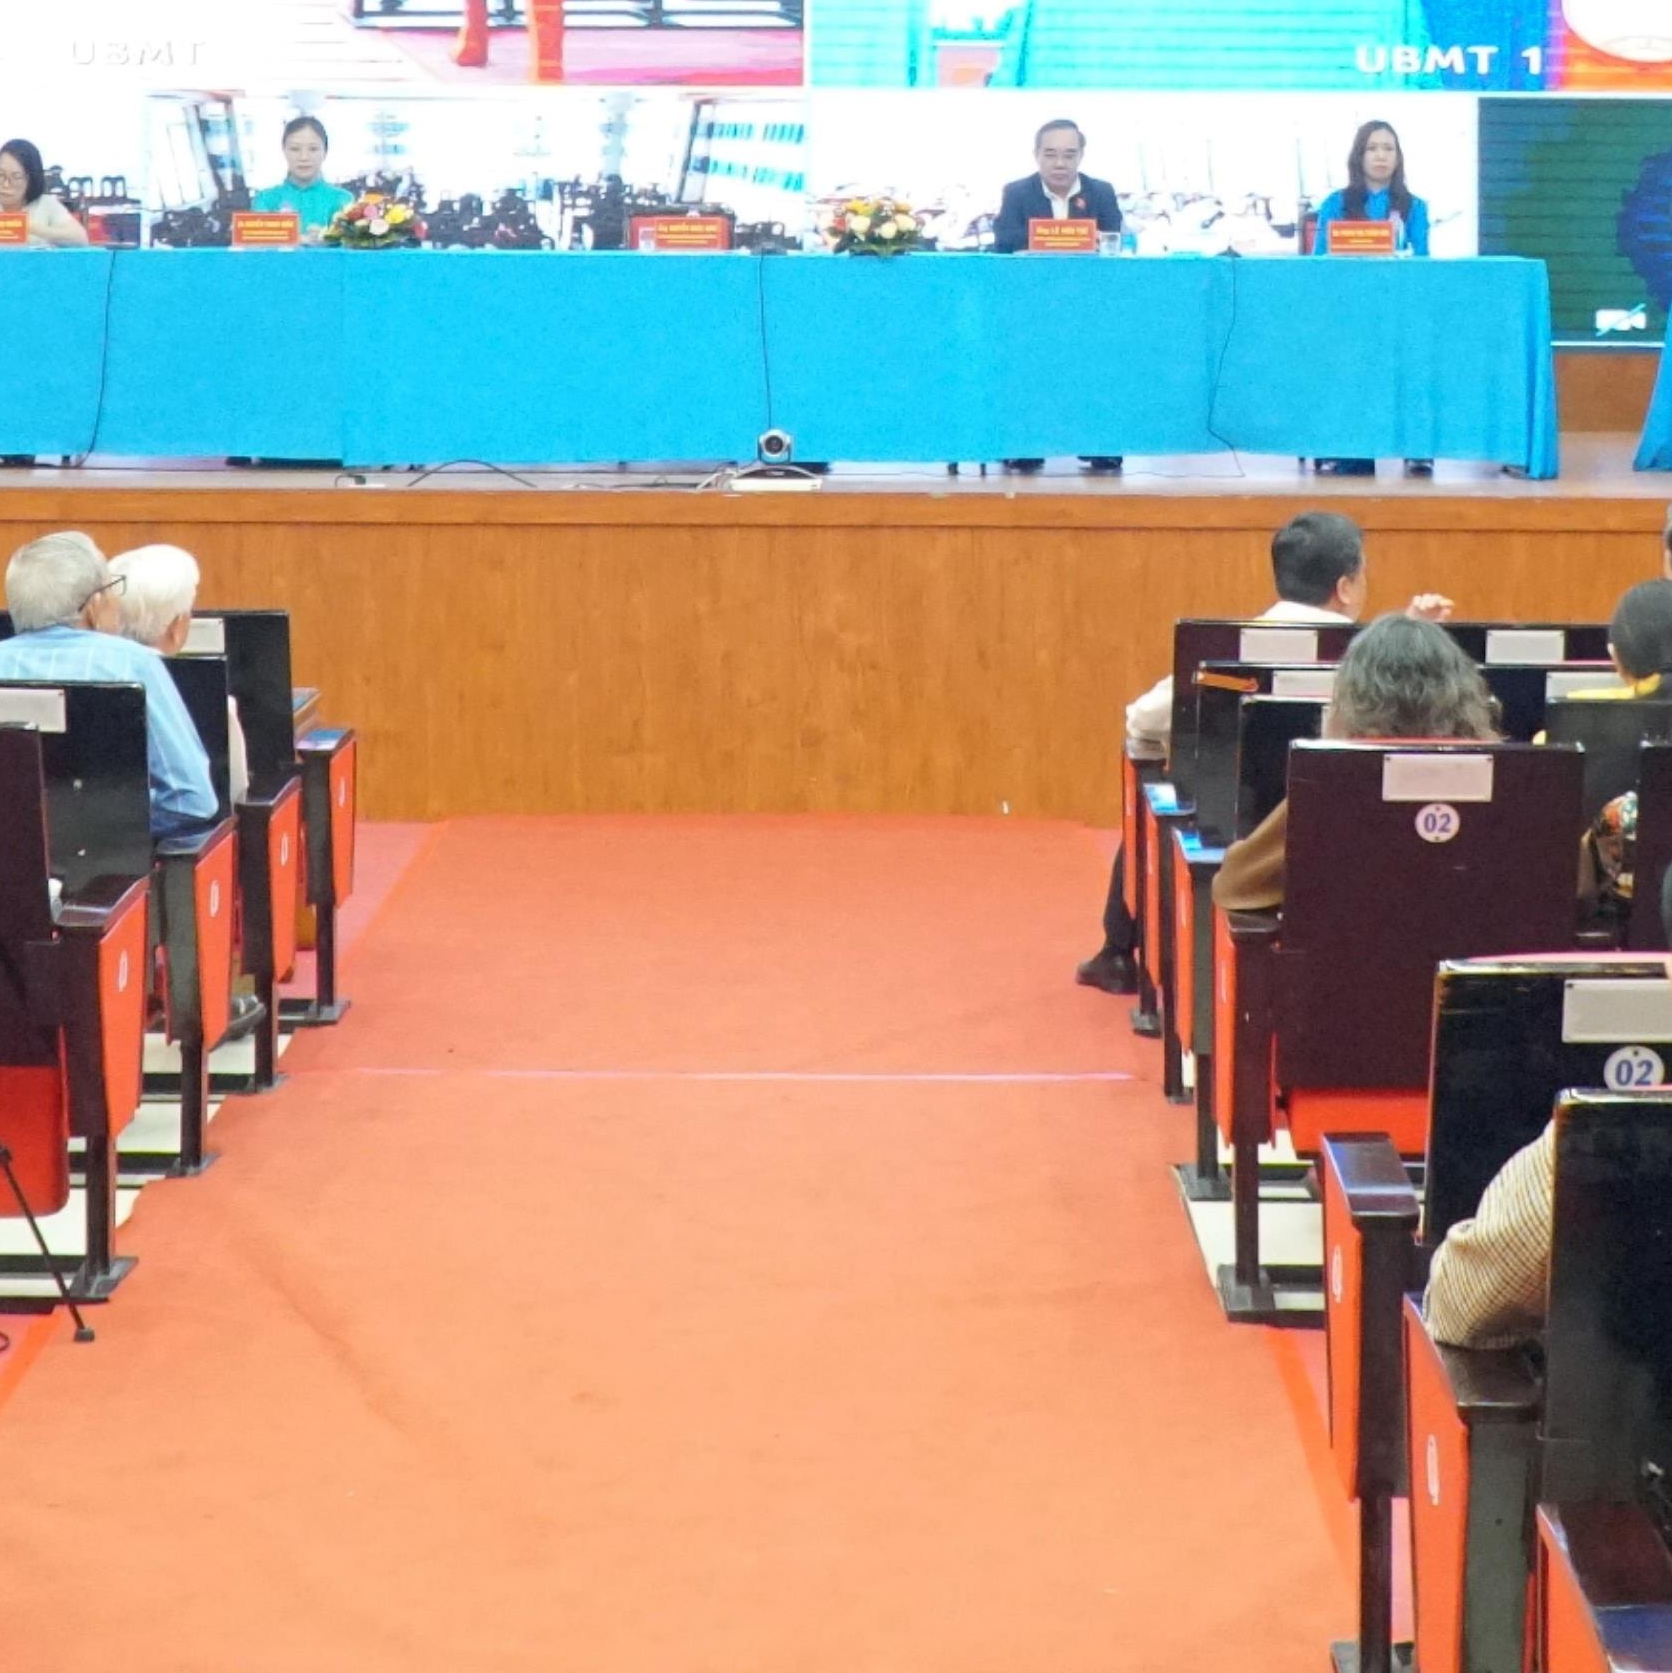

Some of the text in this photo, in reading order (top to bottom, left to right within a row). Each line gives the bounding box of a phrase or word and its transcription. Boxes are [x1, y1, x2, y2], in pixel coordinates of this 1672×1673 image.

[1354, 44, 1499, 76] UBMT
[1423, 812, 1452, 834] 02
[1614, 1058, 1655, 1086] 02
